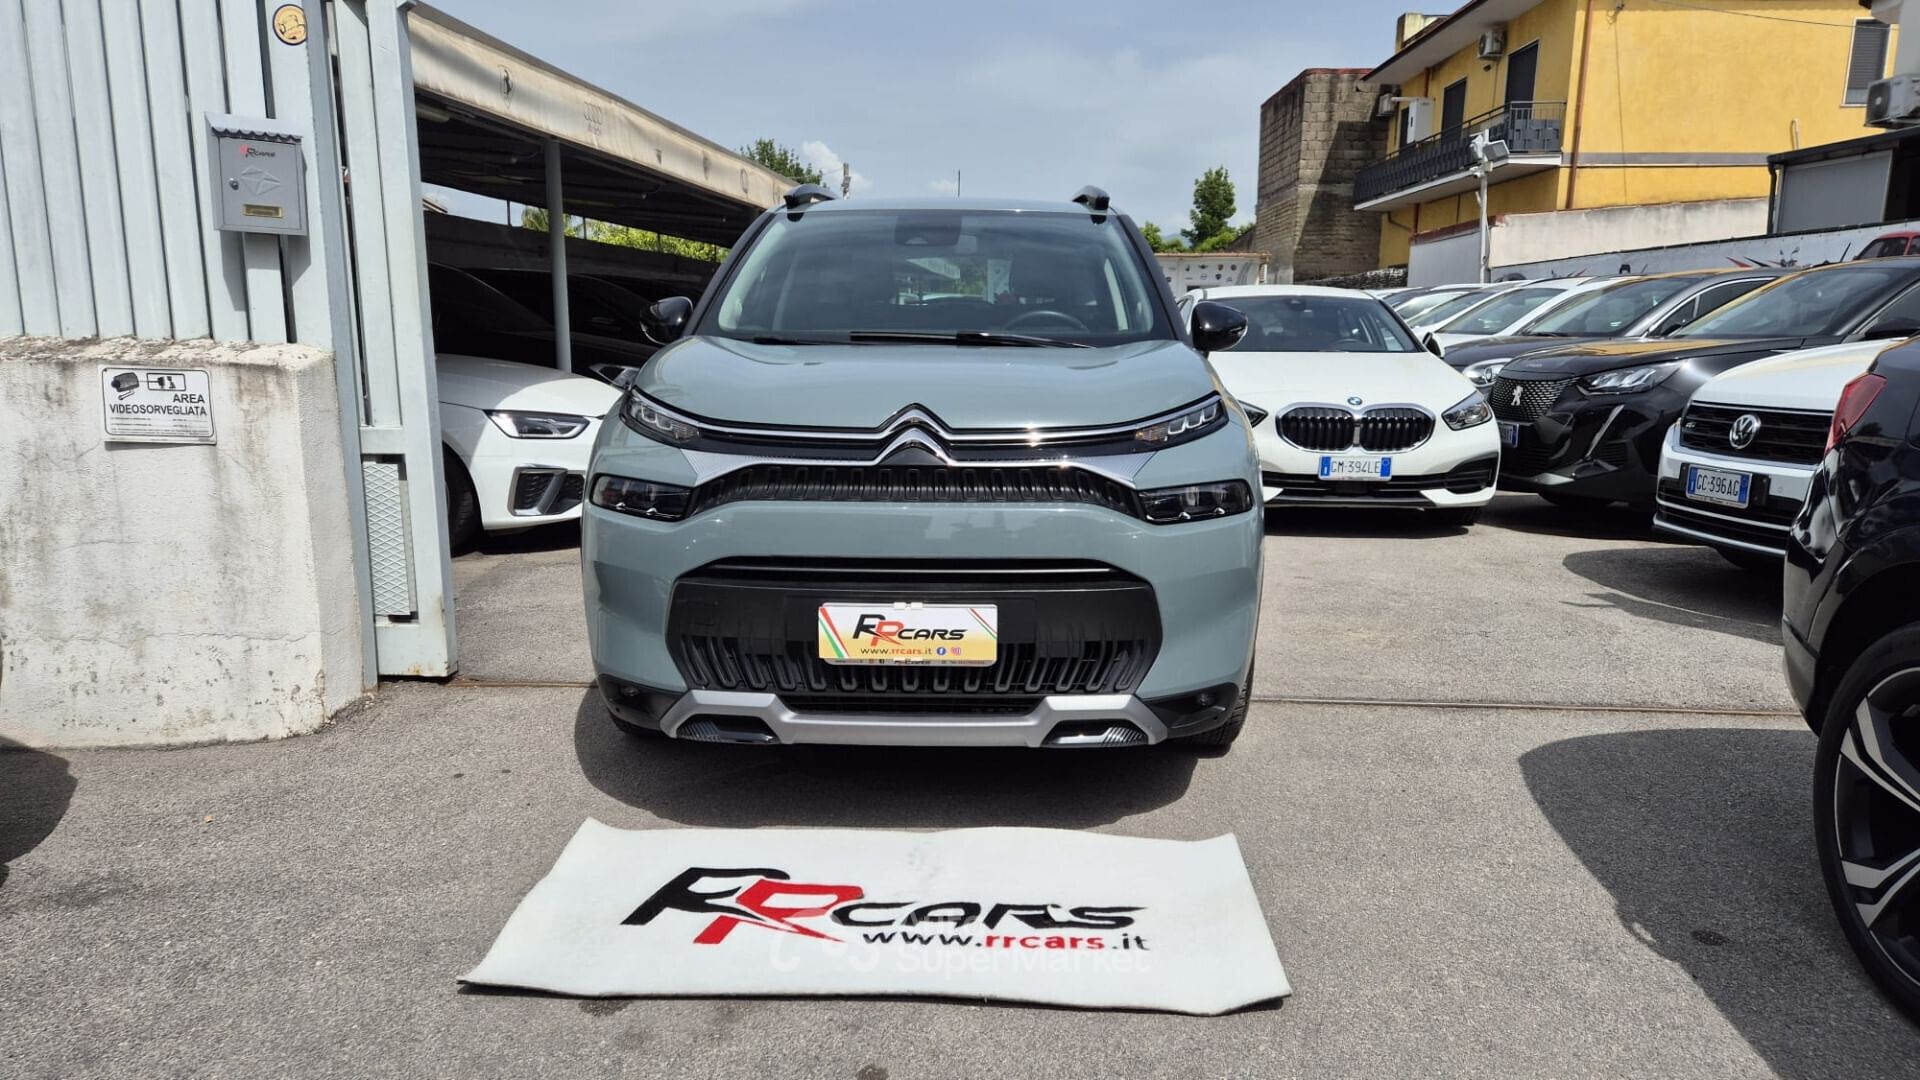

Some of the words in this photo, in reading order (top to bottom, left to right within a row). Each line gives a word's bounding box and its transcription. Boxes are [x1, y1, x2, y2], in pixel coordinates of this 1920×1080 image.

[172, 393, 205, 404] AREA
[109, 403, 207, 416] VIDEOSORVEGLIATA
[861, 647, 932, 655] www.rrcars.it
[862, 932, 1151, 951] www.rrcars.it
